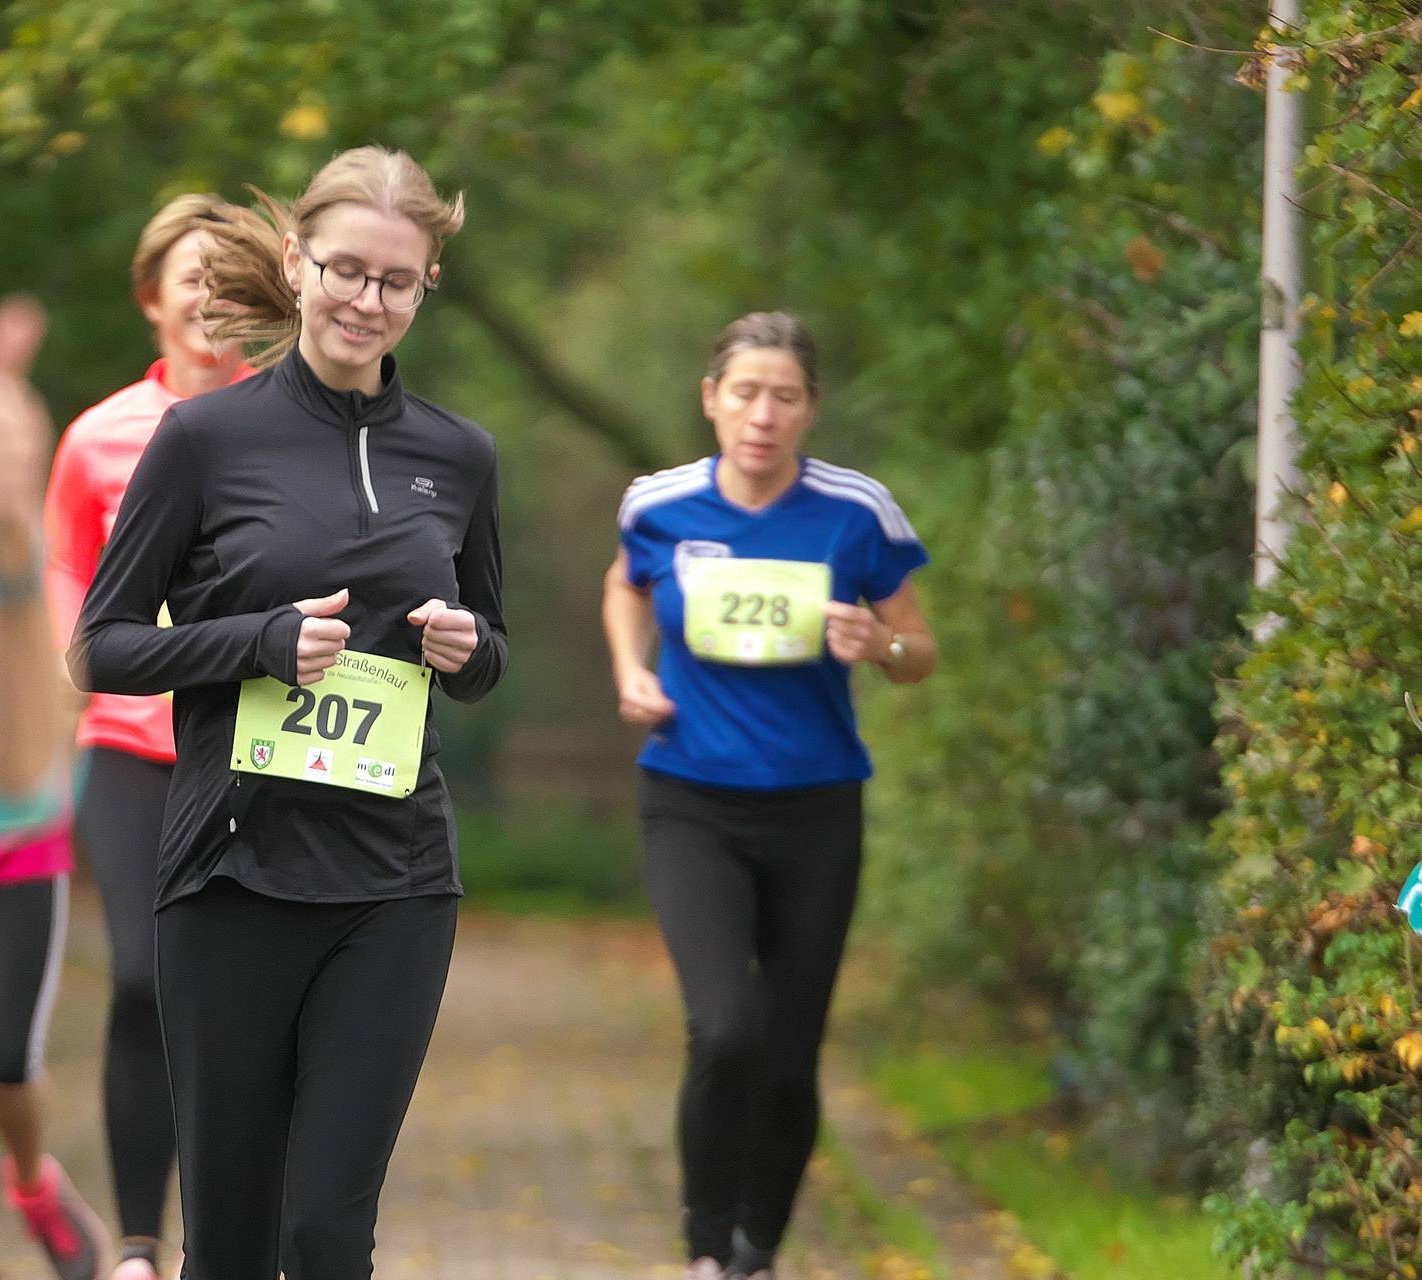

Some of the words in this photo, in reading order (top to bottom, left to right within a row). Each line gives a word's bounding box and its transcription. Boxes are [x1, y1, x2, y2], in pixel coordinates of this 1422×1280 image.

[720, 591, 791, 627] 228
[336, 652, 409, 692] Straßenlauf
[280, 686, 383, 746] 207
